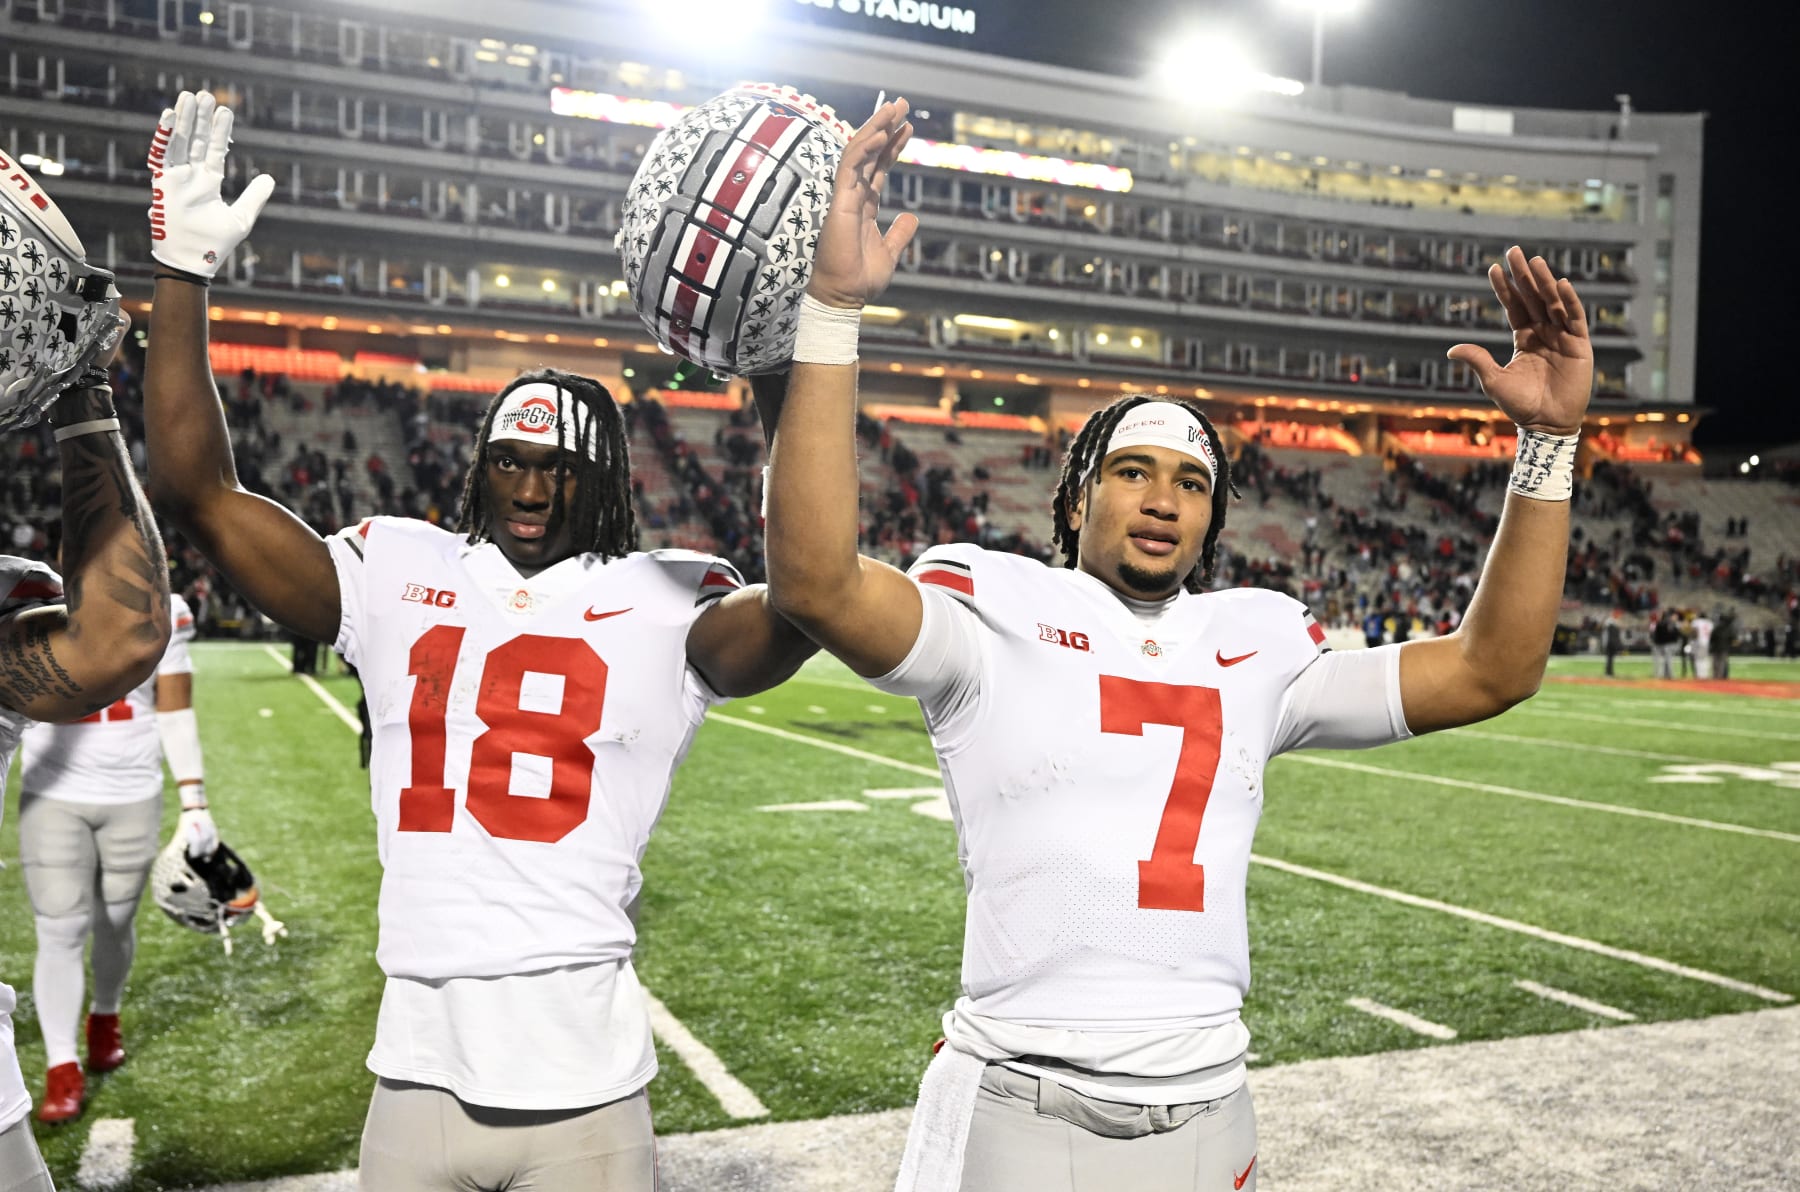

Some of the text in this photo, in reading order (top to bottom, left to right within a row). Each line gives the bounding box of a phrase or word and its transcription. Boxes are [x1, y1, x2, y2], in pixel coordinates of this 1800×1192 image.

[838, 0, 976, 34] STADIUM
[1118, 419, 1166, 435] DEFEND
[397, 624, 609, 844] 18
[1099, 674, 1223, 913] 7
